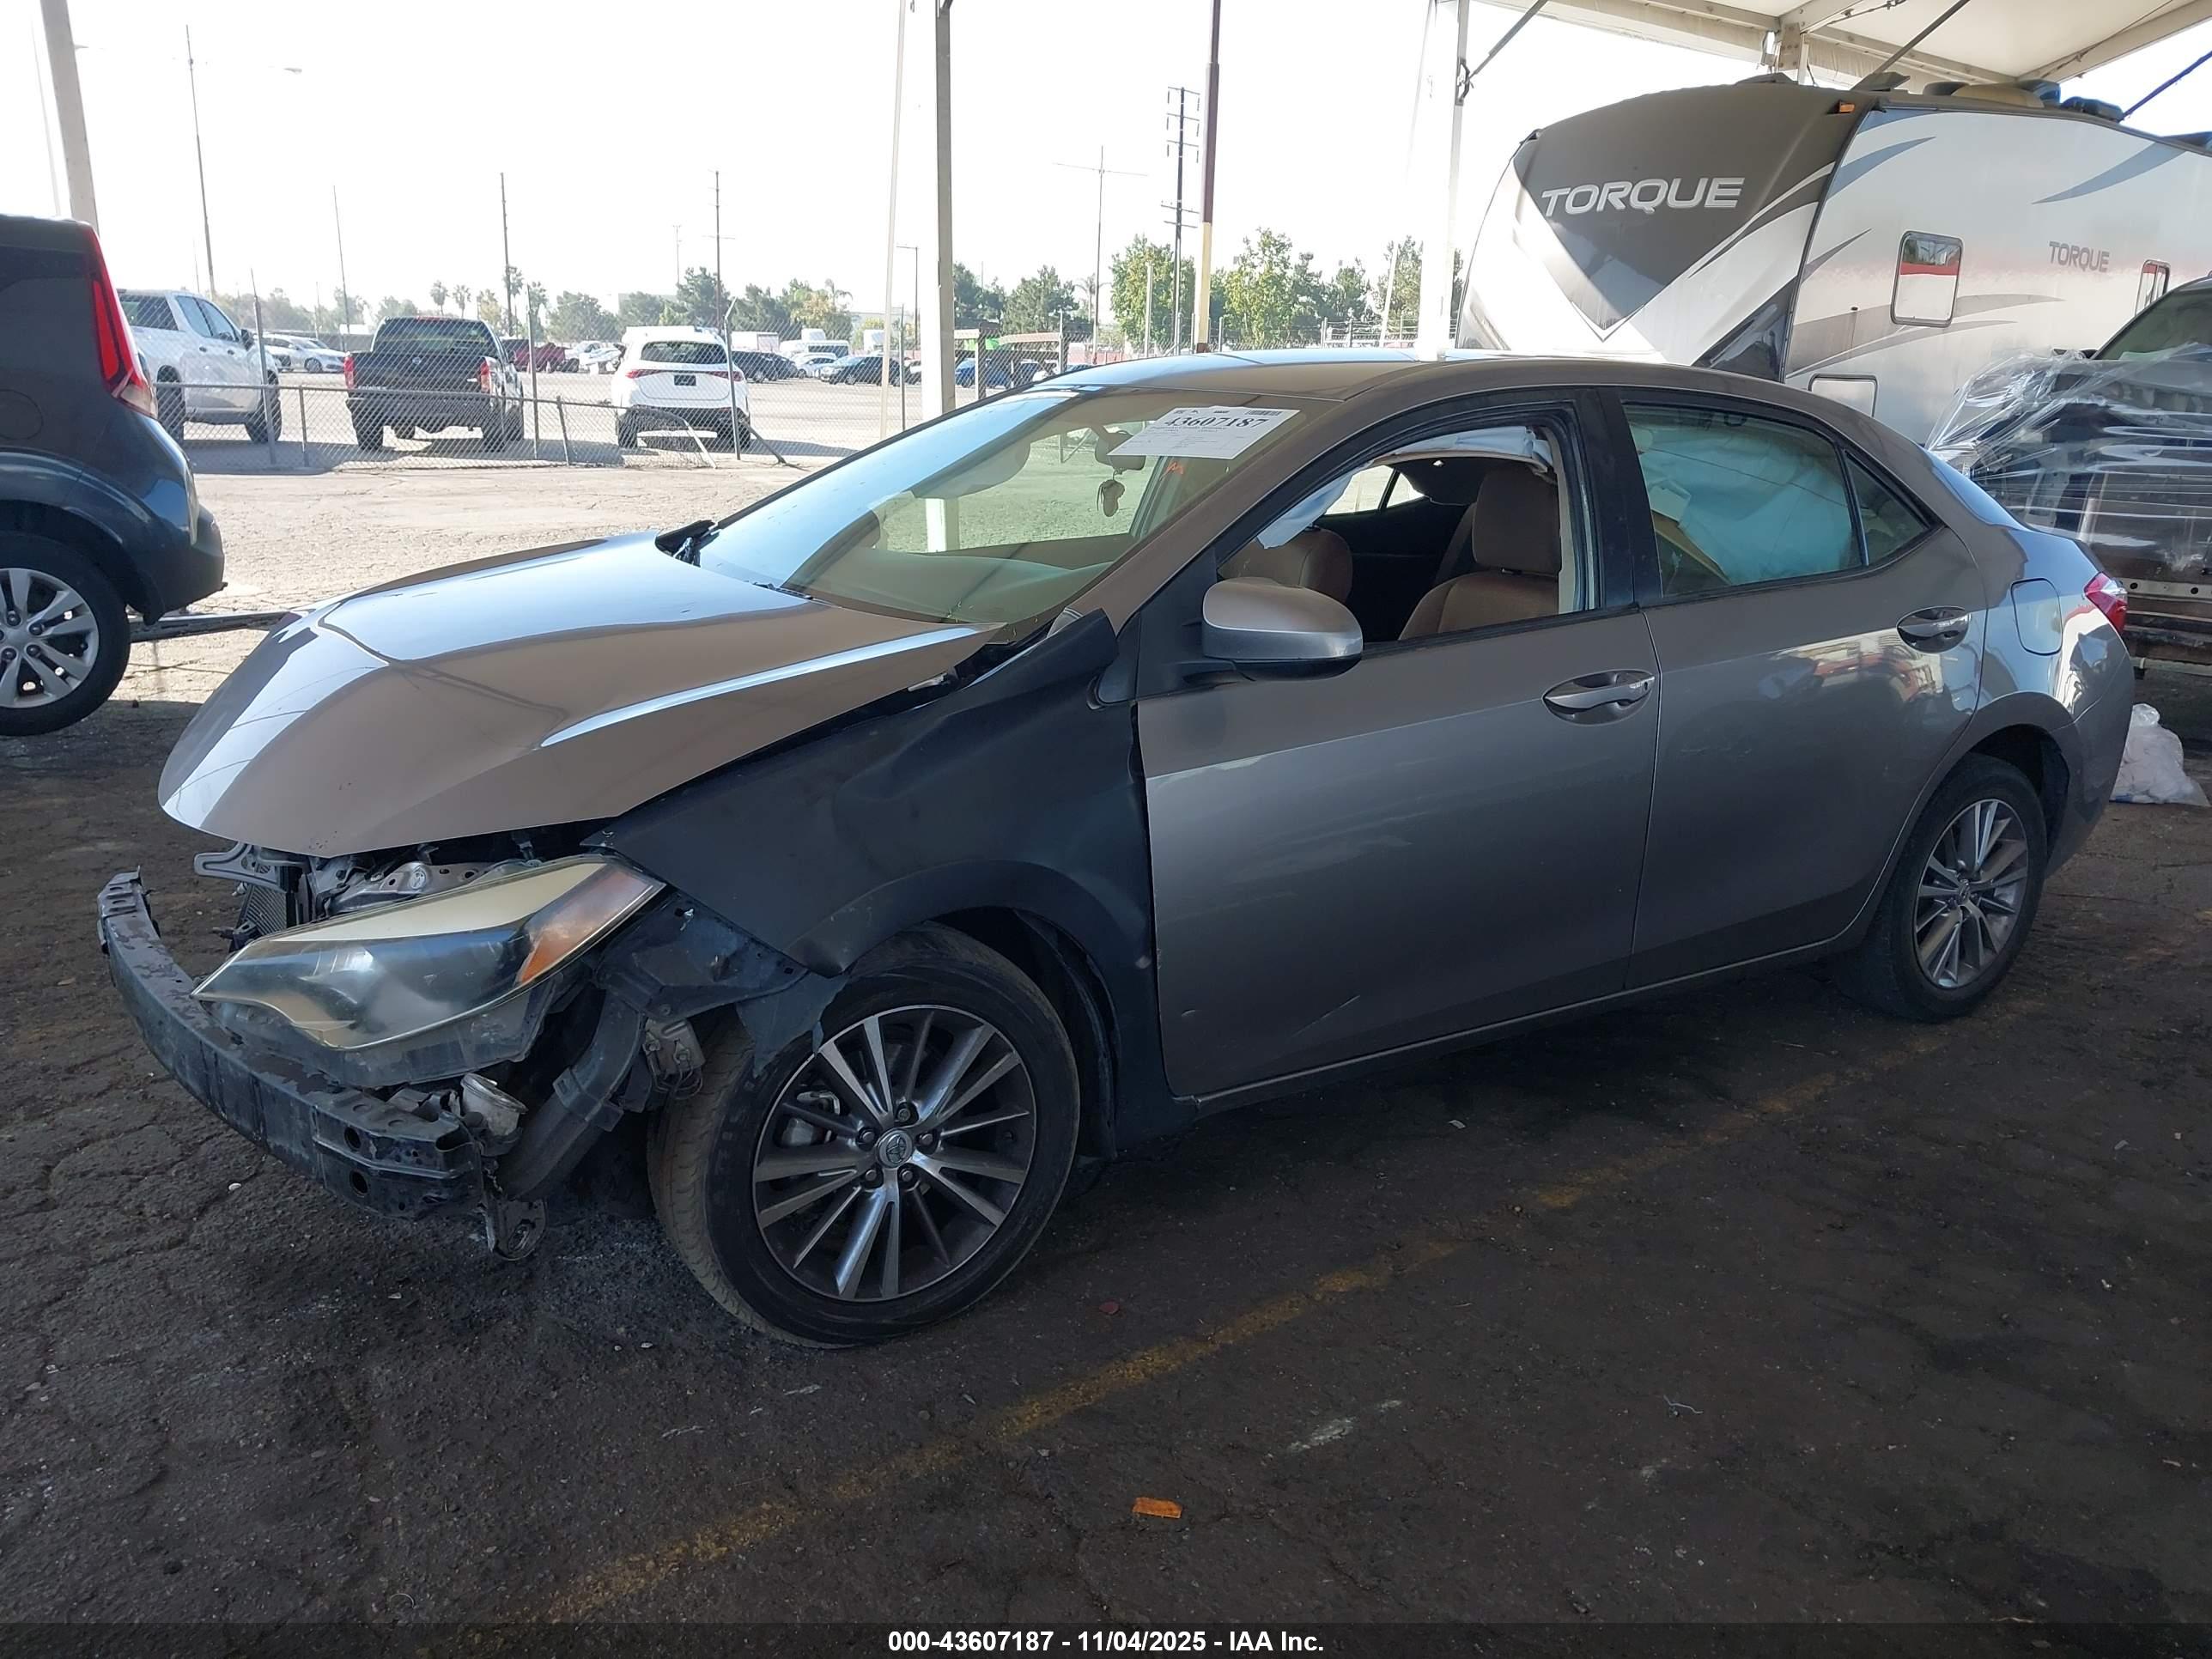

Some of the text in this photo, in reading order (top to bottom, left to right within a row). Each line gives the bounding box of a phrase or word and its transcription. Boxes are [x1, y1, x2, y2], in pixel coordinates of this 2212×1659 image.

[1542, 177, 1745, 216] TORQUE
[2049, 241, 2110, 272] TORQUE
[1164, 416, 1269, 428] 43607187
